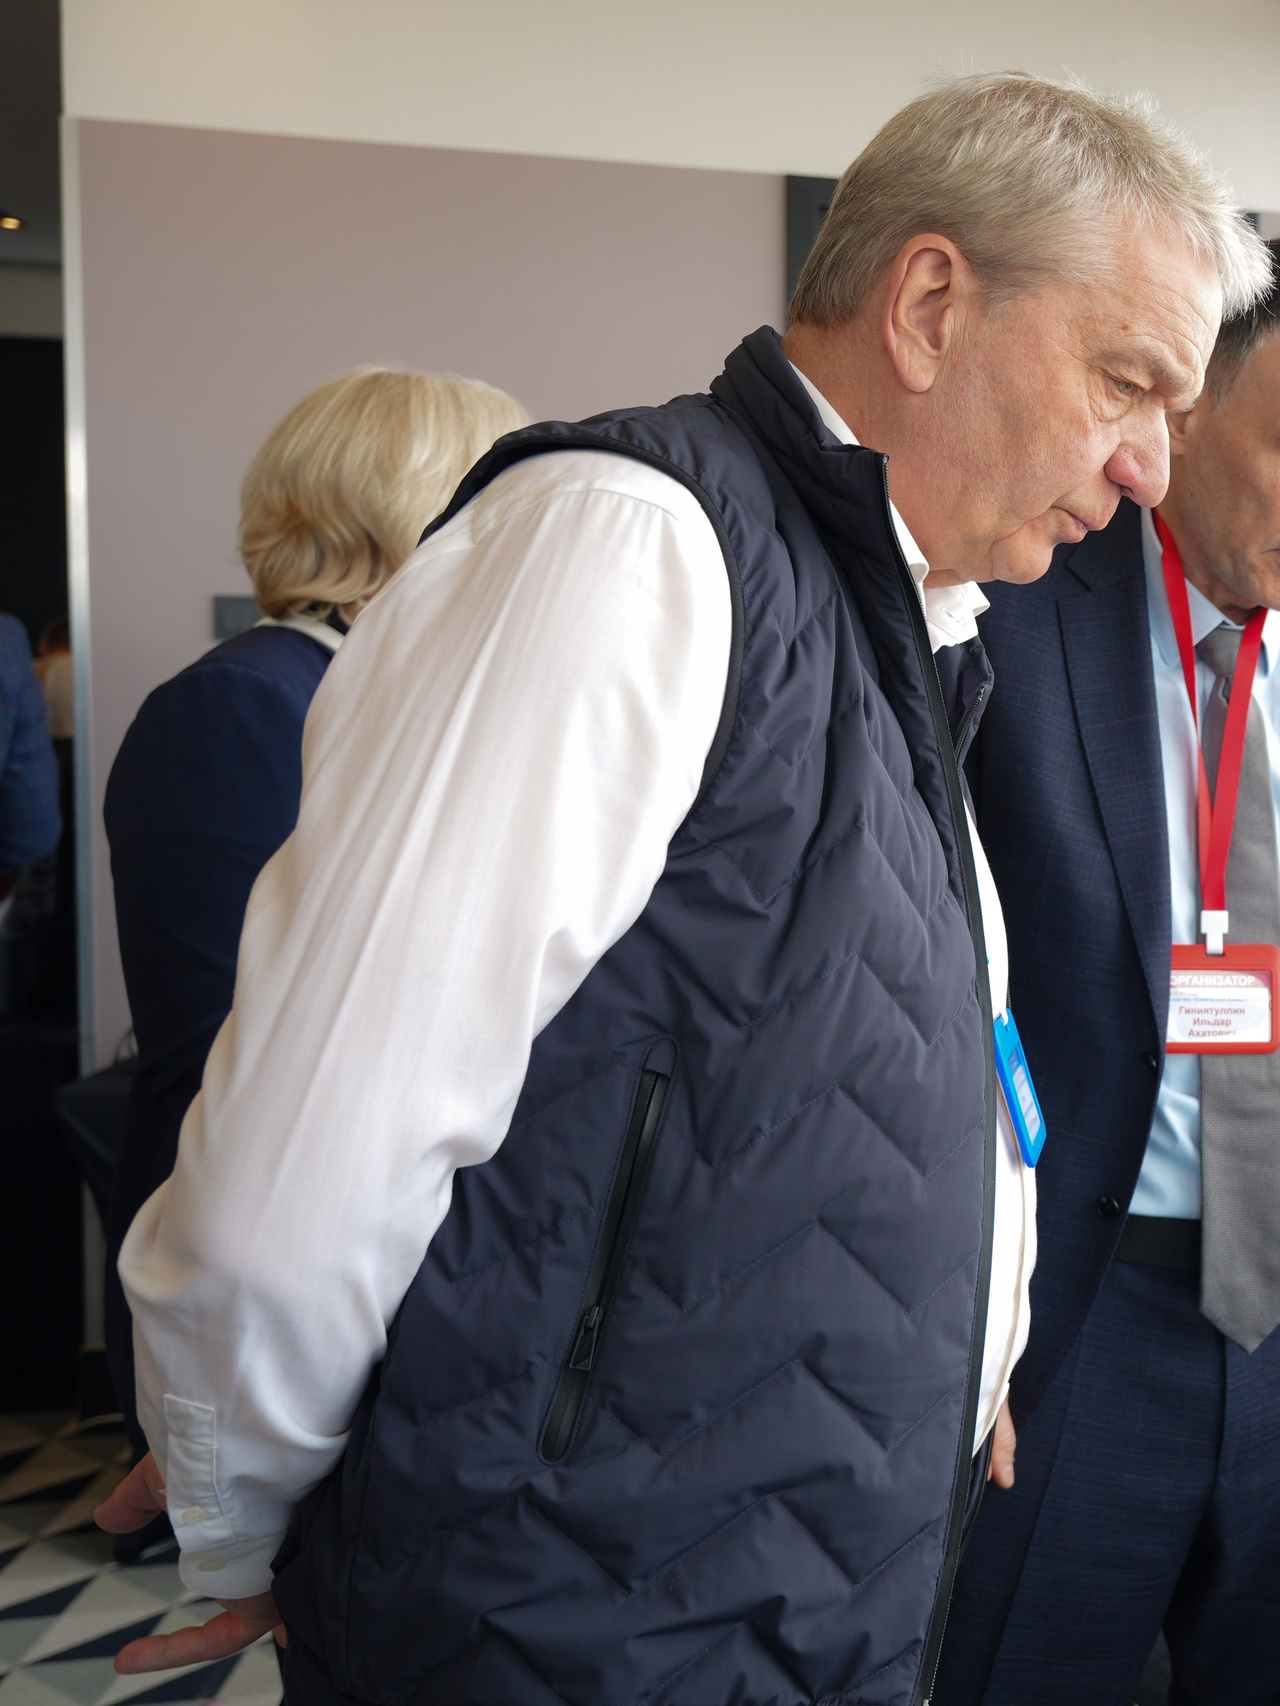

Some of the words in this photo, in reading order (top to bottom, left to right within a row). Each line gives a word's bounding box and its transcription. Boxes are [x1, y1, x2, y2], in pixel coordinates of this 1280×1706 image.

[1170, 974, 1255, 987] ОРГАНИЗАТОР
[1179, 1006, 1245, 1016] Гиниятуллин
[1193, 1017, 1232, 1027] Ильдар
